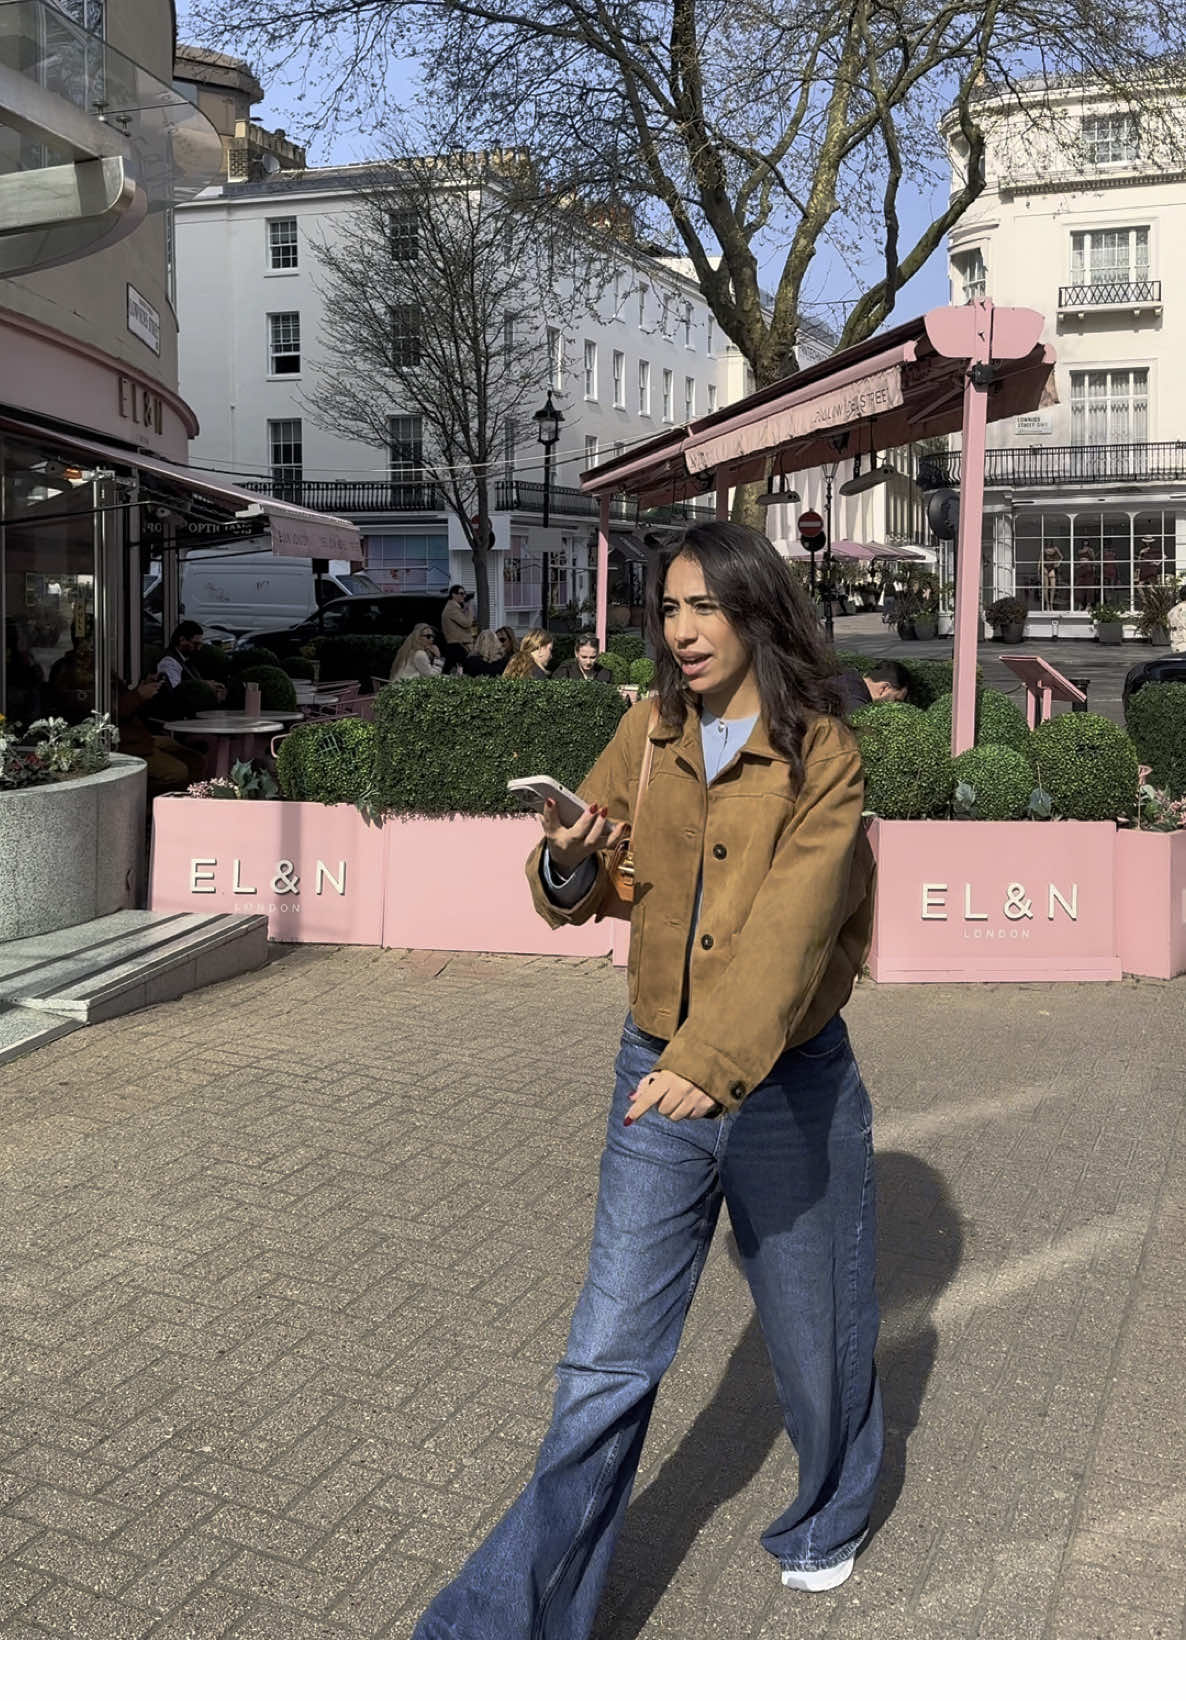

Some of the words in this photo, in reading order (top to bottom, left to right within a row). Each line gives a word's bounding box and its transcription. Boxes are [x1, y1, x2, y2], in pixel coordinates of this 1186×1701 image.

[119, 375, 162, 435] EL&N
[191, 858, 346, 896] EL&N
[234, 903, 301, 912] LONDON
[921, 882, 1078, 921] EL&N
[963, 929, 1030, 938] LONDON
